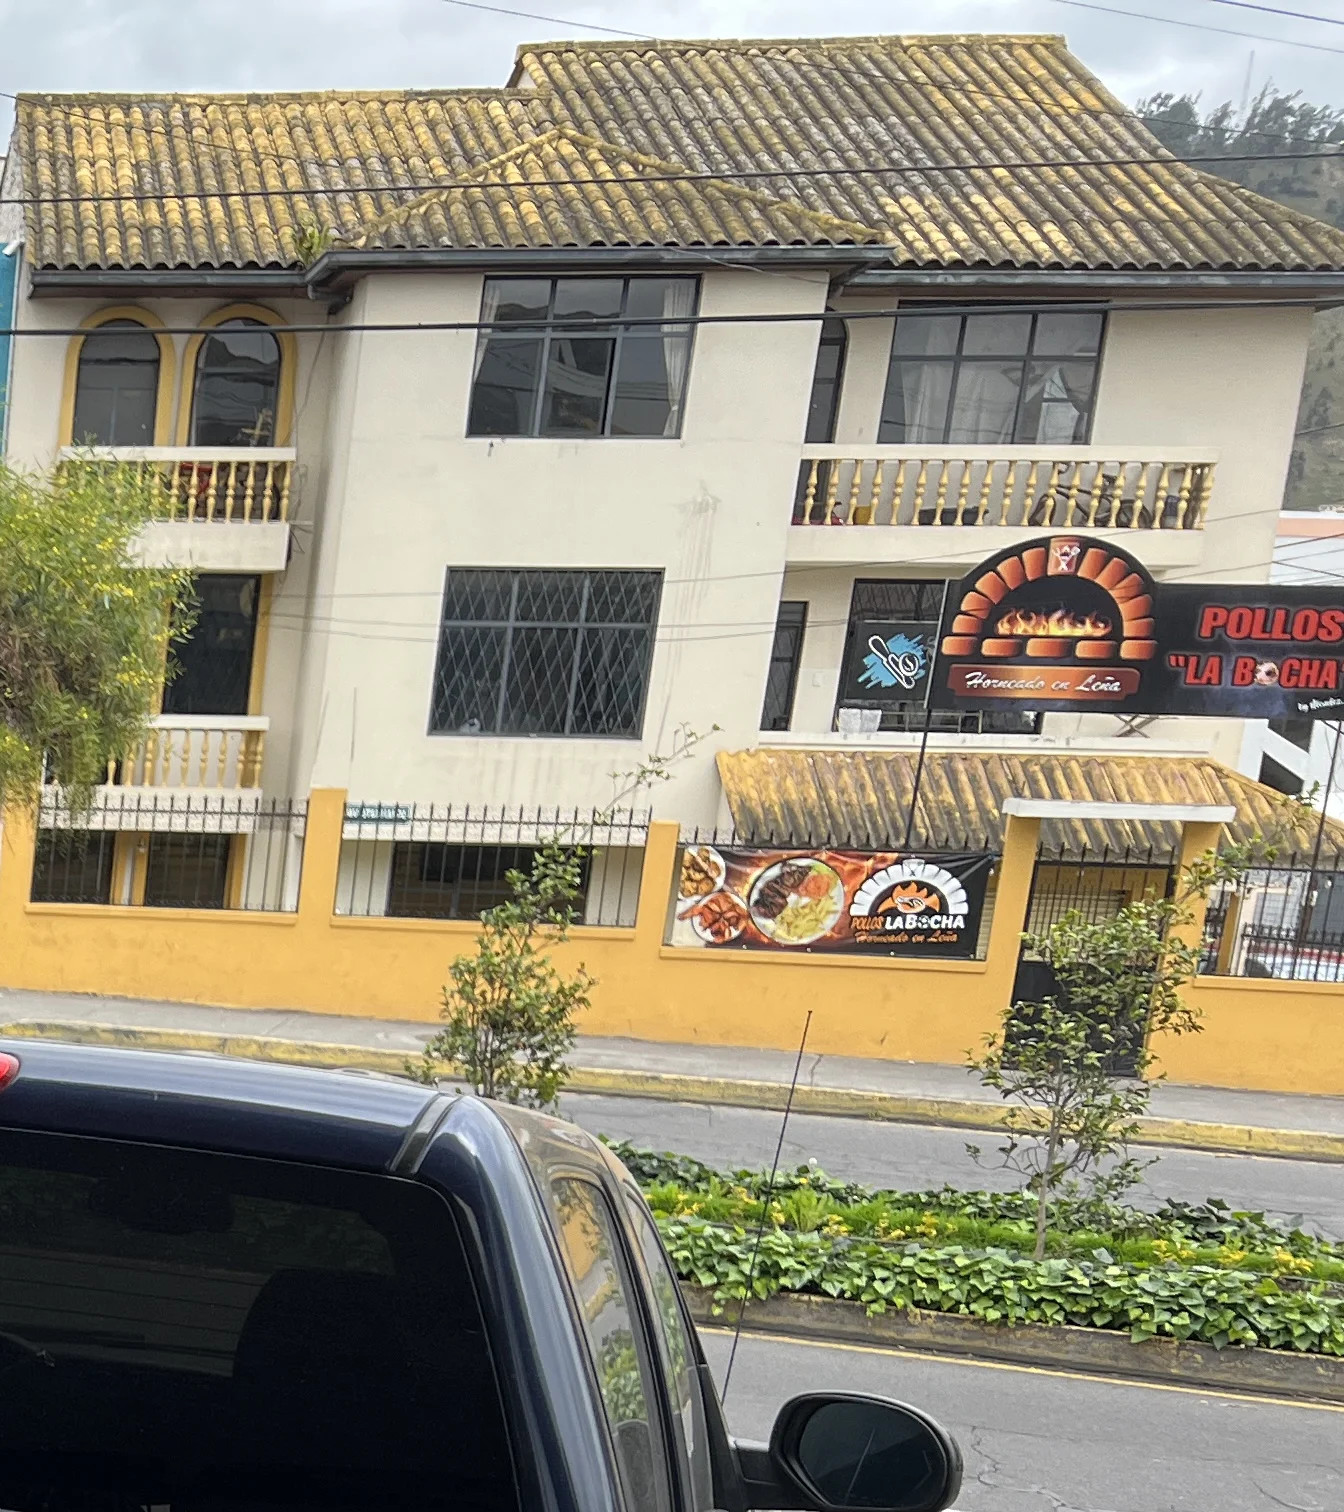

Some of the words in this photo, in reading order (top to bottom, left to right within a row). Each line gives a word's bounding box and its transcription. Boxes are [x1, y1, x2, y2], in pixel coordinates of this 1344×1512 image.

[1198, 606, 1344, 642] POLLOS
[964, 671, 1046, 690] Horneado
[1050, 680, 1071, 691] en
[1074, 674, 1122, 692] Leña
[850, 916, 884, 930] POLLOS
